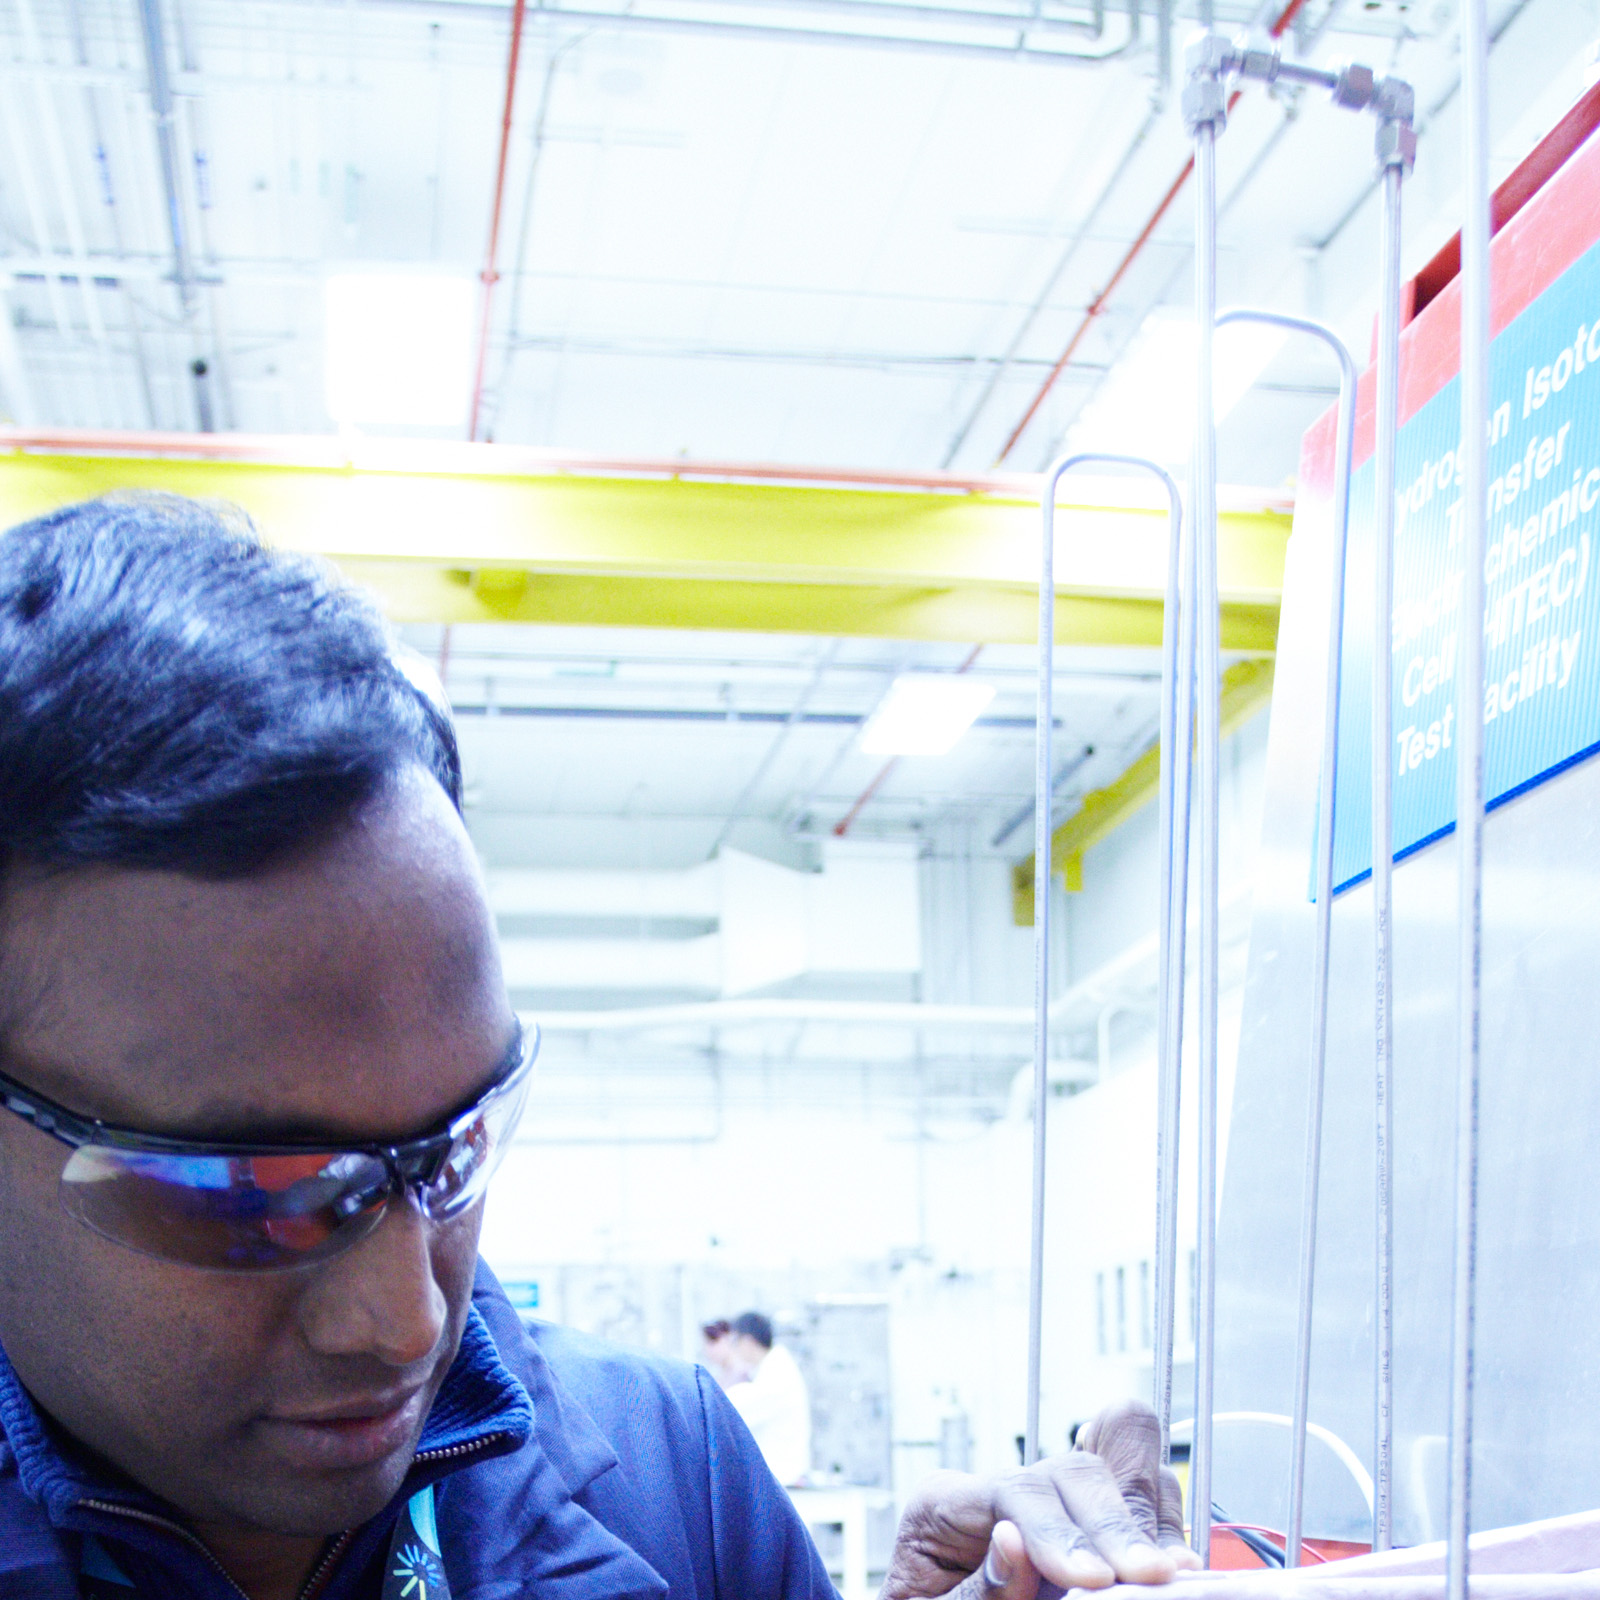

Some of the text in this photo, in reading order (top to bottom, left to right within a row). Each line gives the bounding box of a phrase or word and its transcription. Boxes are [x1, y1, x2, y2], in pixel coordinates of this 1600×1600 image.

[1397, 629, 1581, 777] Test acility
[1402, 632, 1456, 708] Cell
